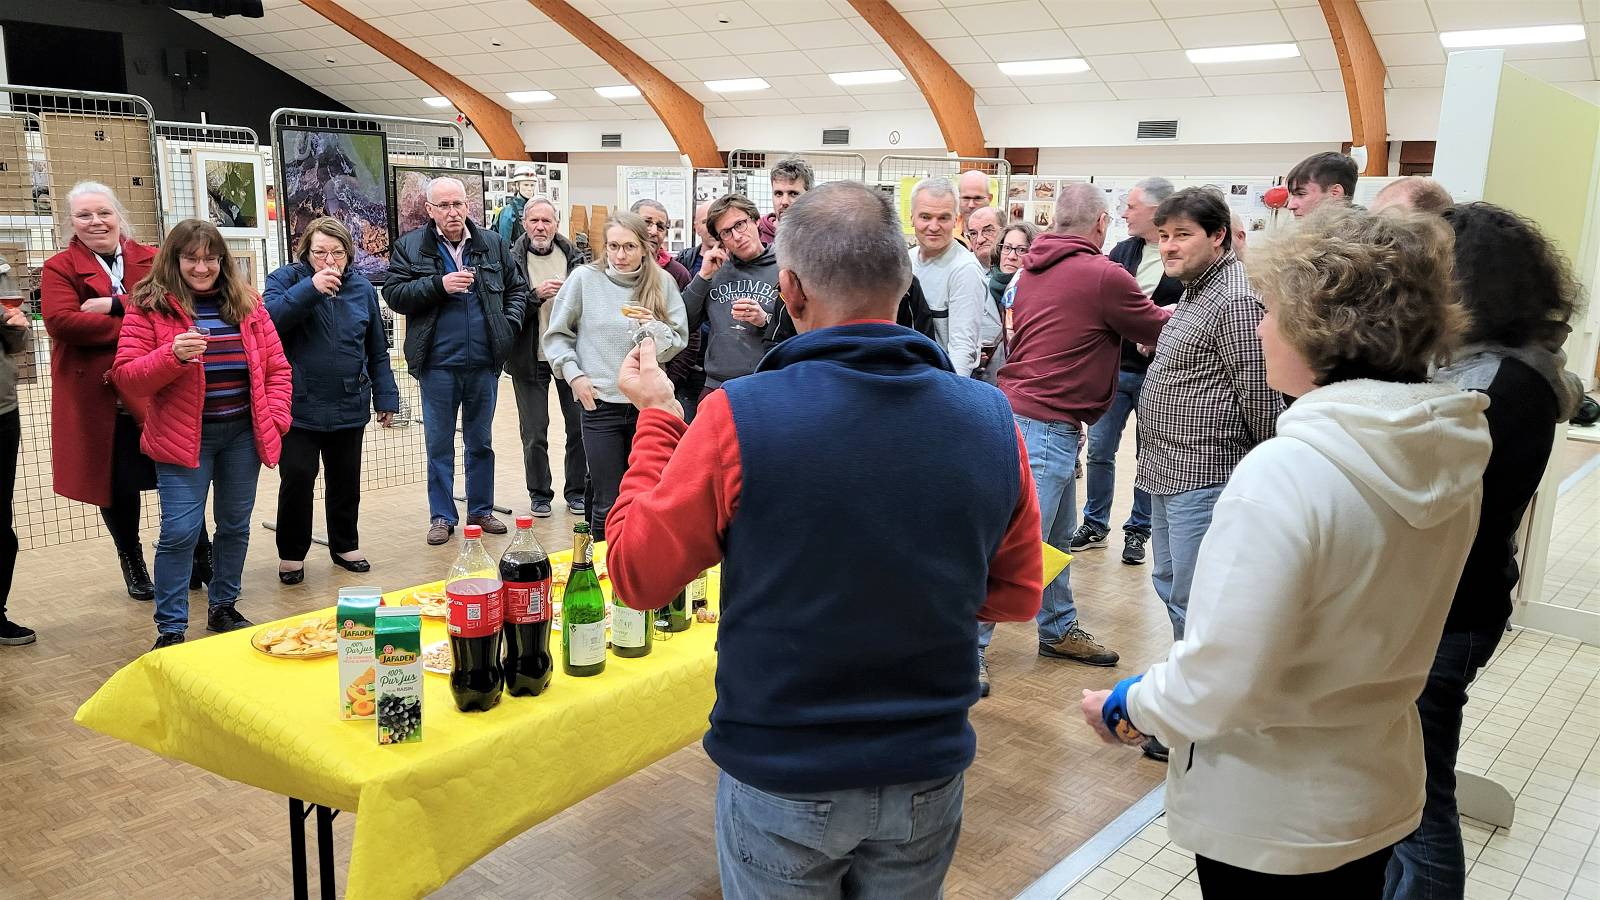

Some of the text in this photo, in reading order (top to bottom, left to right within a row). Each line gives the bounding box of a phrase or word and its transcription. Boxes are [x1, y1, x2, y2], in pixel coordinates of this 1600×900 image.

[709, 279, 778, 301] COLUMBI
[719, 292, 772, 306] UNIVERSITY
[344, 629, 374, 638] JAFADEN
[383, 654, 414, 663] JAFADEN
[388, 668, 404, 677] 100%
[380, 675, 399, 687] Pur
